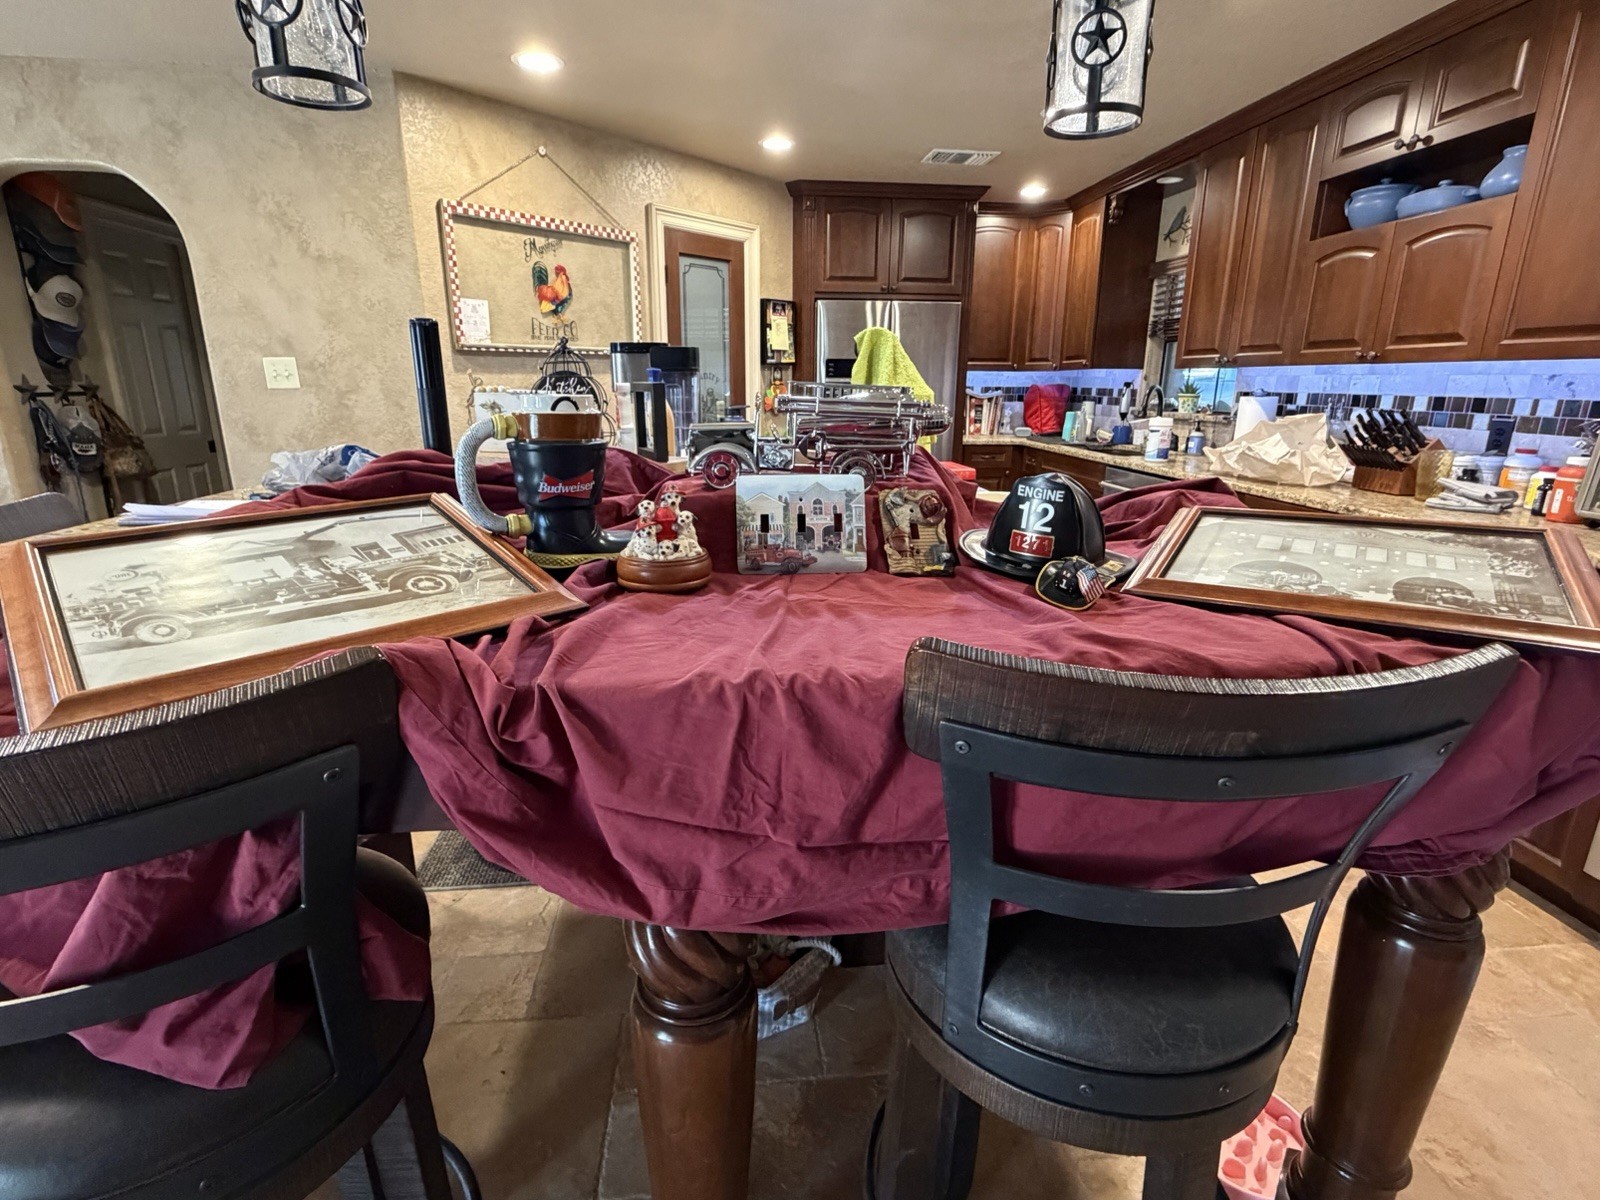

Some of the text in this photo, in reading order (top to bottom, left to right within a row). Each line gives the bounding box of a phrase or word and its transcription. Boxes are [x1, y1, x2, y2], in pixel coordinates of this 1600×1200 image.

[538, 481, 595, 493] Budweiser
[1017, 484, 1065, 502] ENGINE
[1019, 501, 1055, 532] 12
